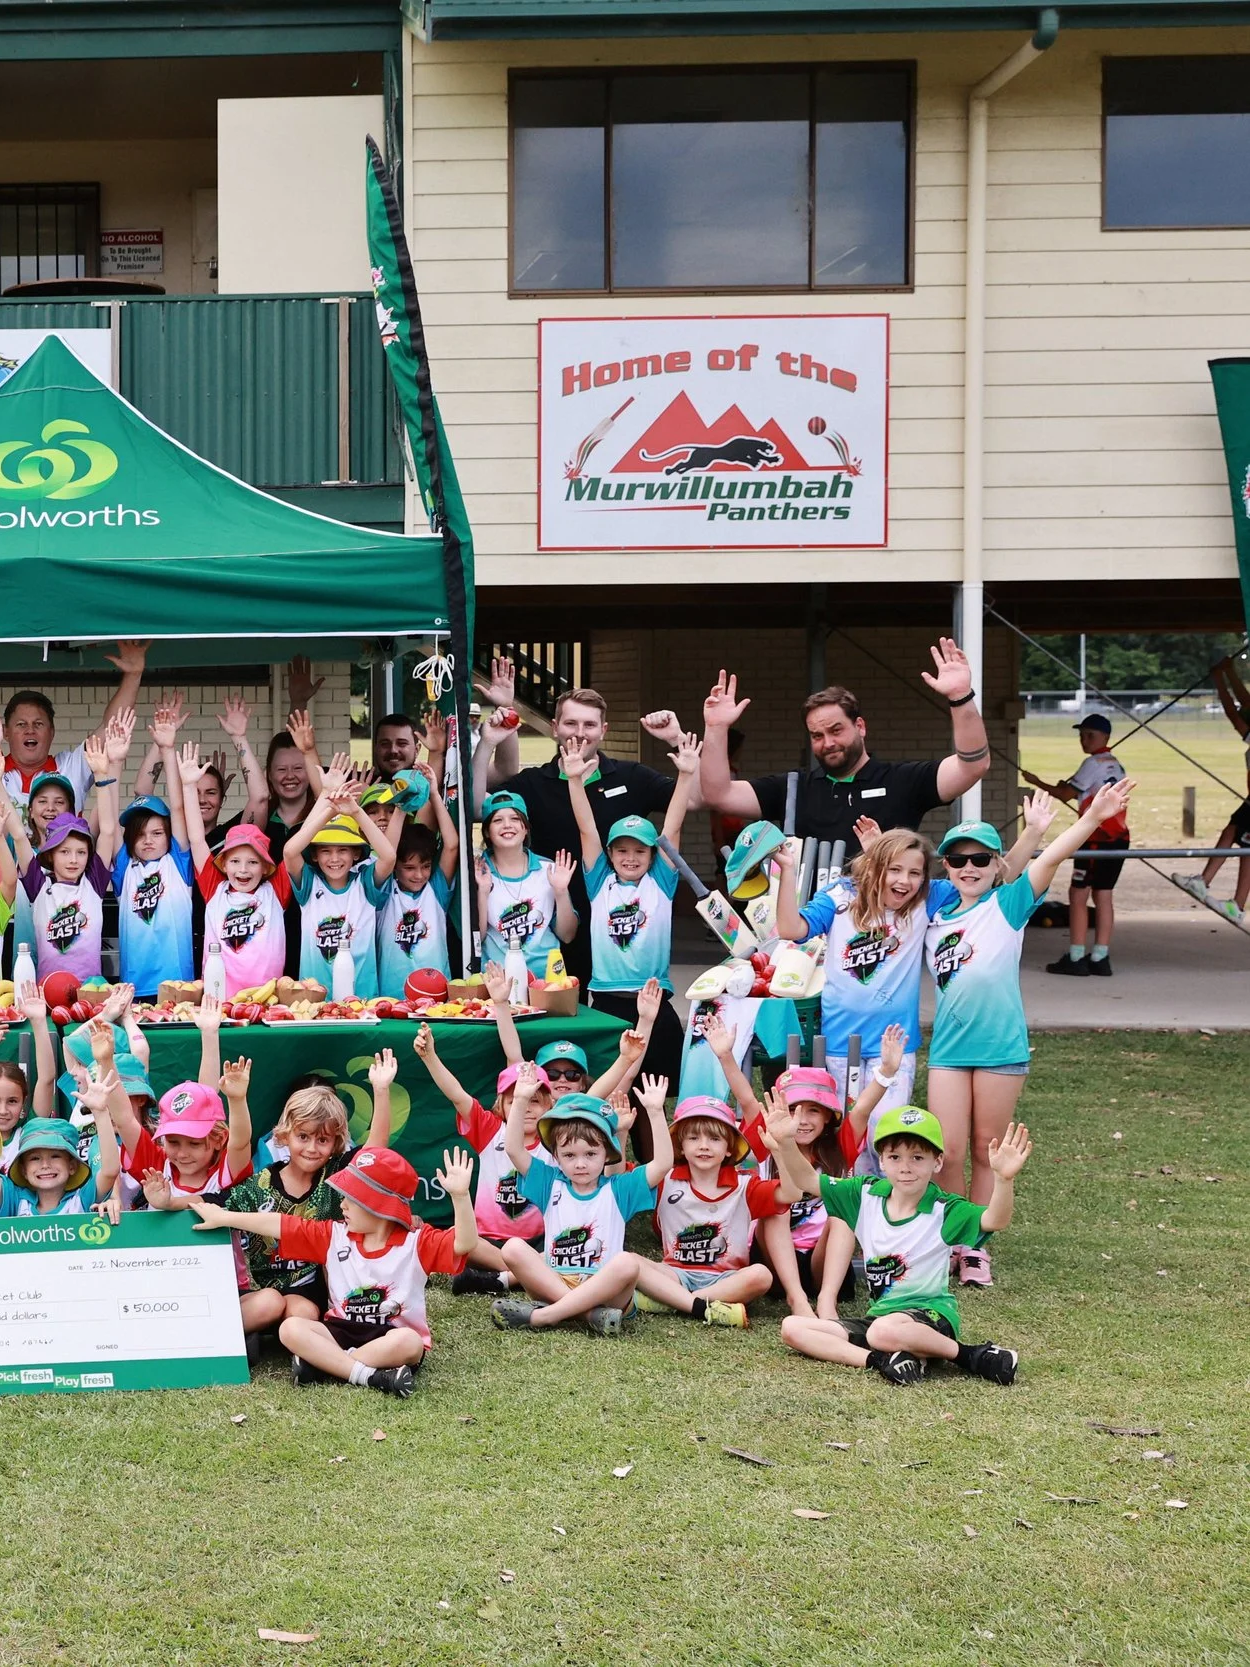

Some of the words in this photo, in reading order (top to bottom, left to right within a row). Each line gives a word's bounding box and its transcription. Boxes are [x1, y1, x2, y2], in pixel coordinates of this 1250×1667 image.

[101, 235, 115, 243] NO
[117, 234, 159, 242] ALCOHOL
[561, 350, 691, 397] Home
[707, 343, 759, 371] of
[775, 352, 858, 393] the
[564, 474, 853, 501] Murwillumbah
[706, 502, 851, 521] Panthers
[502, 914, 527, 929] CRICKET
[47, 922, 81, 940] BLAST
[221, 921, 257, 938] BLAST
[848, 940, 882, 957] CRICKET
[842, 945, 889, 970] BLAST
[496, 1193, 527, 1204] BLAS
[553, 1243, 583, 1255] CRICKET
[678, 1239, 710, 1250] CRICKET
[551, 1250, 595, 1268] BLAST
[673, 1247, 719, 1263] BLAST
[92, 1261, 107, 1269] 22
[110, 1258, 167, 1269] November
[172, 1257, 201, 1266] 2022
[18, 1290, 42, 1300] Club
[11, 1309, 48, 1321] dollars
[122, 1304, 130, 1313] $
[345, 1304, 378, 1313] CRICKET
[22, 1371, 52, 1381] fresh
[54, 1376, 80, 1388] Play
[84, 1375, 112, 1385] fresh
